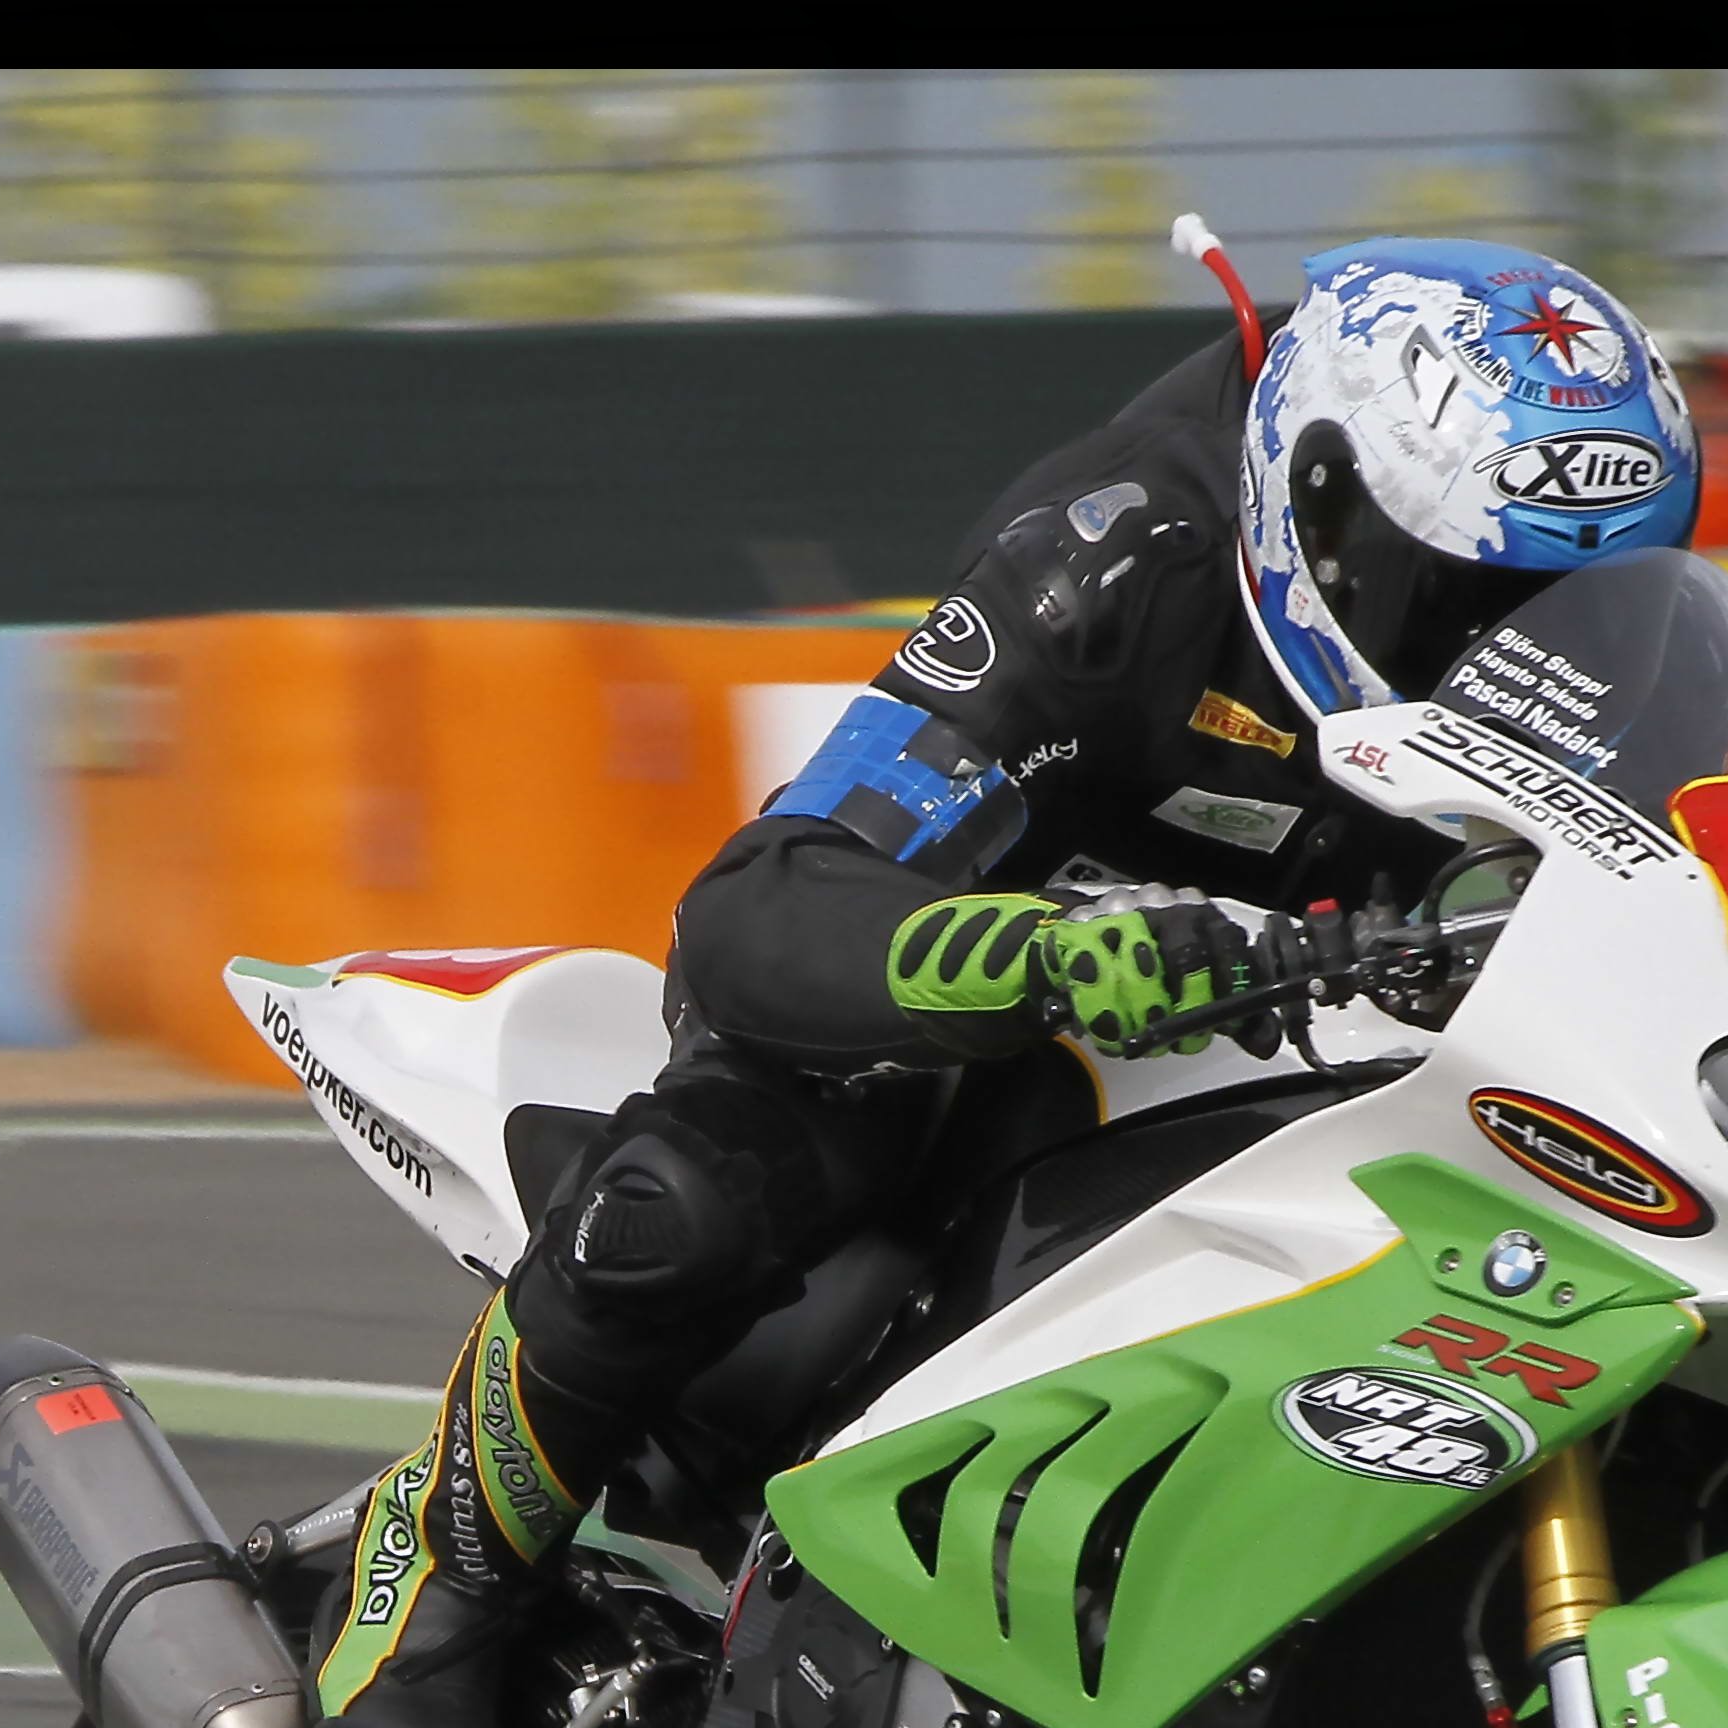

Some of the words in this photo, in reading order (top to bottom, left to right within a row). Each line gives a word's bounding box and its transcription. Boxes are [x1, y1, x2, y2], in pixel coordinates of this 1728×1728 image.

[1518, 443, 1652, 497] X-lite
[1474, 647, 1538, 687] Hayato
[1536, 678, 1599, 721] Takada
[1493, 627, 1548, 664] Björn
[1543, 654, 1613, 698] Stuppi
[1449, 664, 1534, 720] Pascal
[1521, 703, 1619, 769] Nadalet
[1416, 719, 1668, 866] SCHUBERT
[1505, 794, 1623, 873] MOTORS
[260, 991, 433, 1199] voelpker.com
[1476, 1104, 1658, 1205] Held
[1308, 1375, 1478, 1430] NRT
[1390, 1312, 1602, 1410] RR
